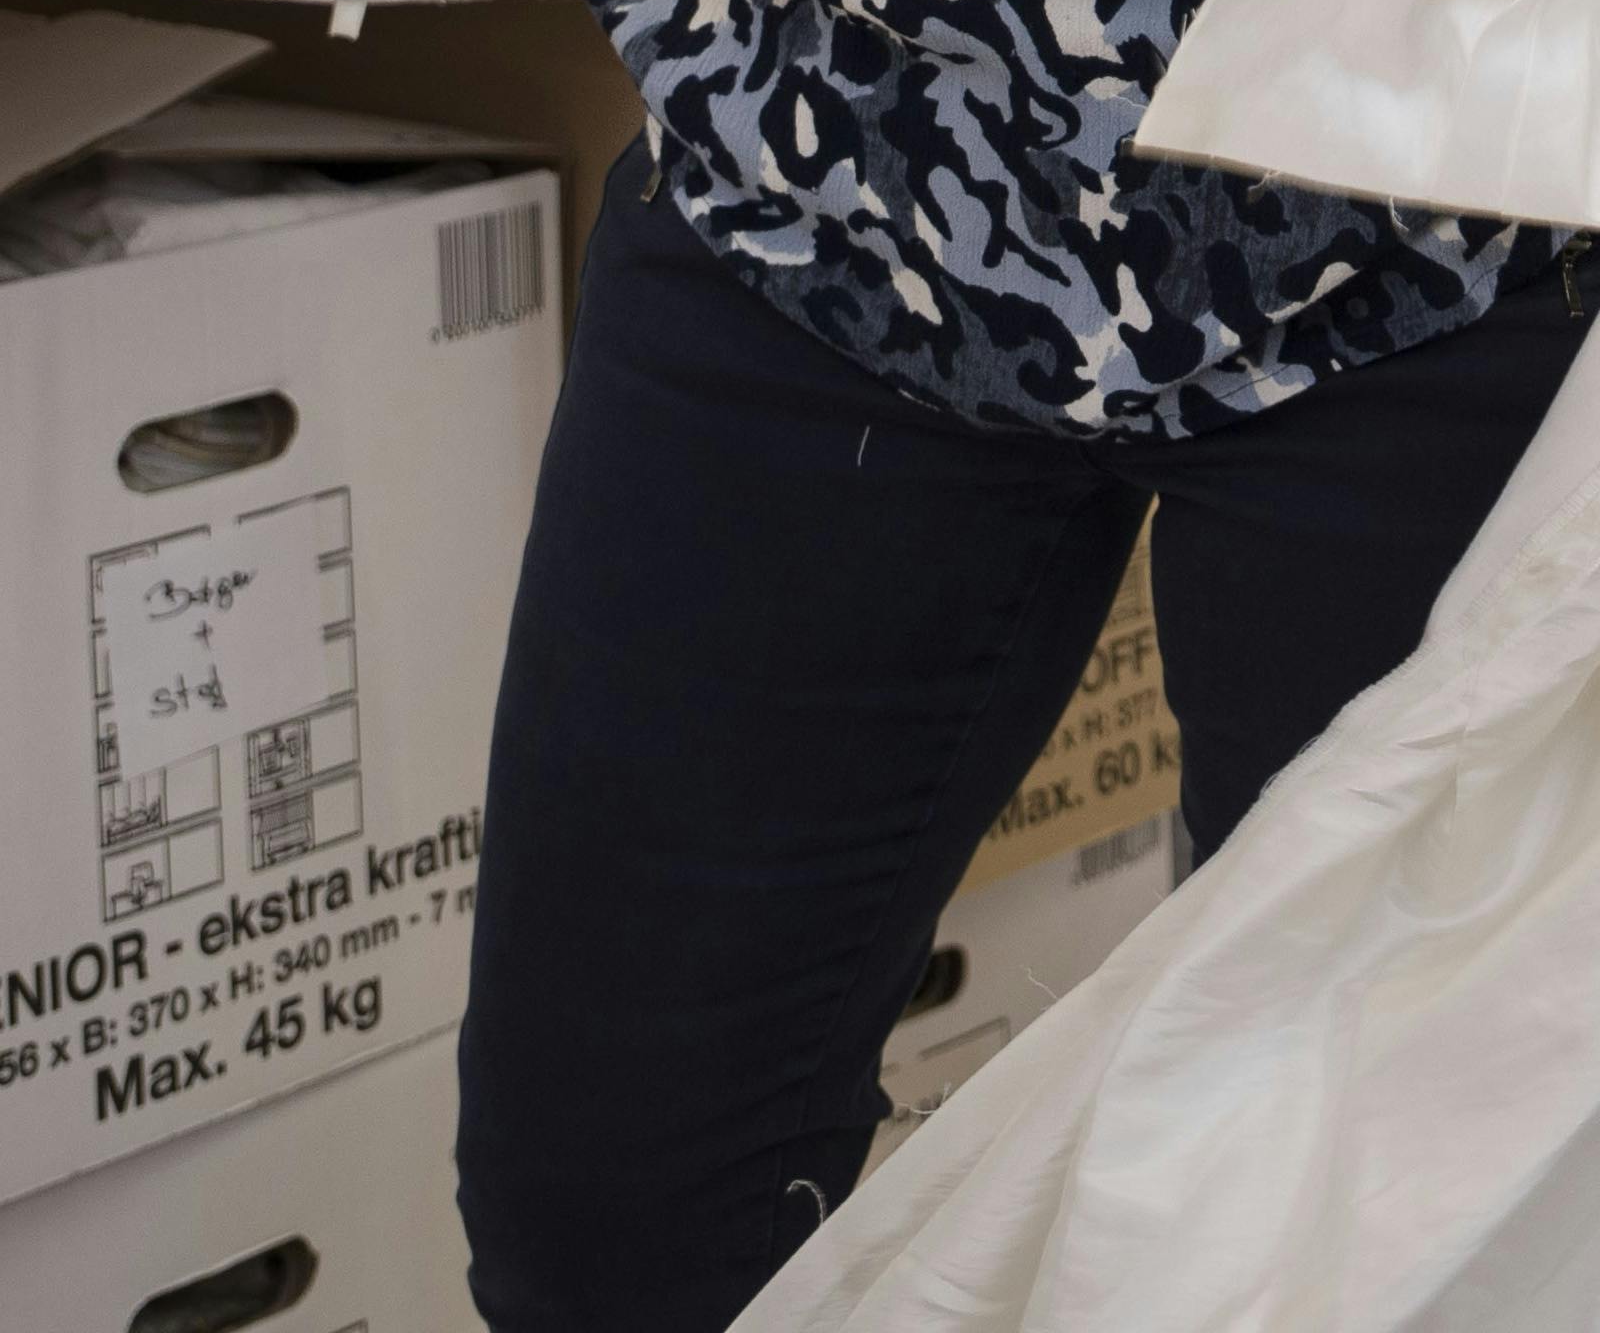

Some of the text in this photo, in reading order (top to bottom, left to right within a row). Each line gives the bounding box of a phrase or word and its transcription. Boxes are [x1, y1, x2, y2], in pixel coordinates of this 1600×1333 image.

[1096, 740, 1141, 796] 60
[0, 929, 147, 1027] NIOR
[199, 867, 352, 956] ekstra
[49, 1035, 70, 1069] x
[83, 1016, 118, 1055] B:
[129, 985, 190, 1037] 370
[200, 983, 220, 1014] x
[229, 961, 265, 1001] H:
[274, 933, 332, 985] 340
[339, 914, 400, 959] mm
[430, 889, 447, 925] 7
[95, 974, 383, 1123] Max. 45 kg
